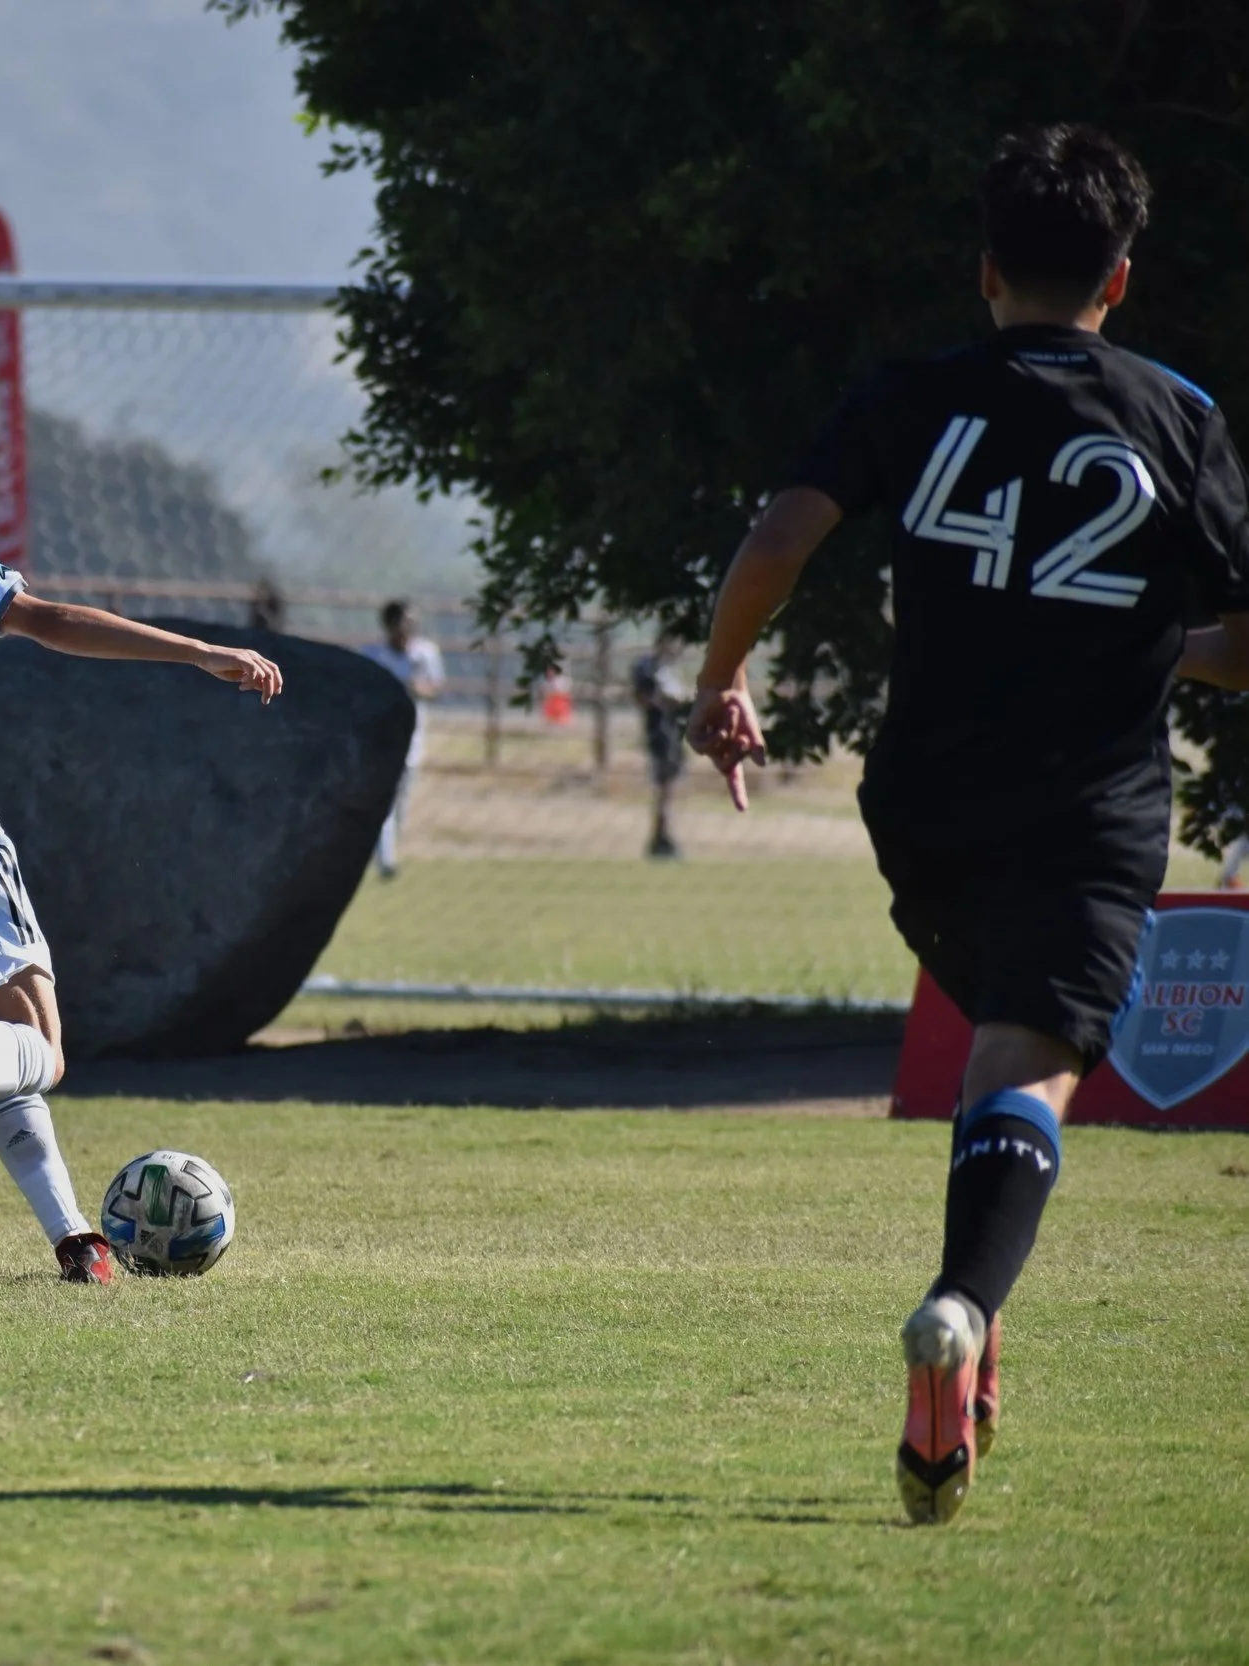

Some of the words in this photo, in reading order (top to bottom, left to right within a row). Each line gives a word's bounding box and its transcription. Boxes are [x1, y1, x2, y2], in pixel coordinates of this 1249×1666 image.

[902, 415, 1156, 608] 42
[1161, 1010, 1203, 1035] SC
[1141, 1043, 1169, 1056] SAN
[1172, 1043, 1214, 1056] DIEGO
